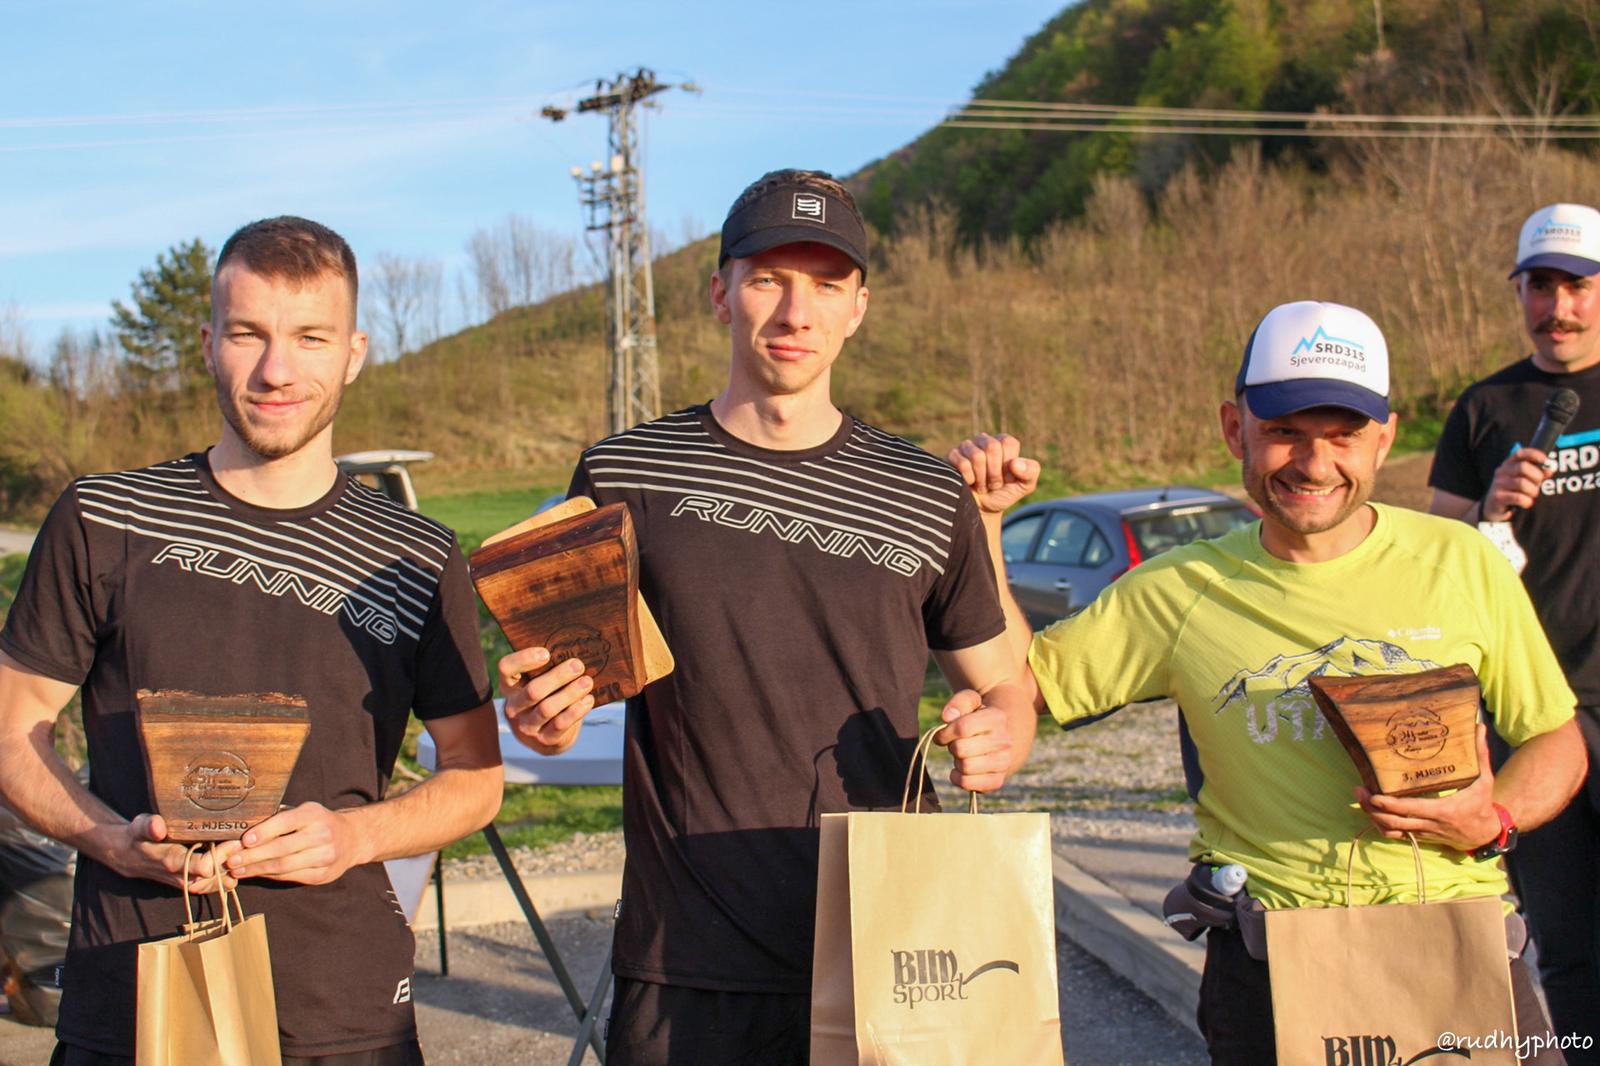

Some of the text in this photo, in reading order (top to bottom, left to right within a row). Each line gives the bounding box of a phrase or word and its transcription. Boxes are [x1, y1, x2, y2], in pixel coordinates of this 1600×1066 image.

[1315, 342, 1365, 362] SRD315
[1290, 356, 1367, 373] Sjeverozapad
[670, 495, 922, 578] RUNNING
[151, 543, 398, 645] RUNNING
[1416, 764, 1456, 779] MJESTO
[187, 821, 249, 831] 2. MJESTO
